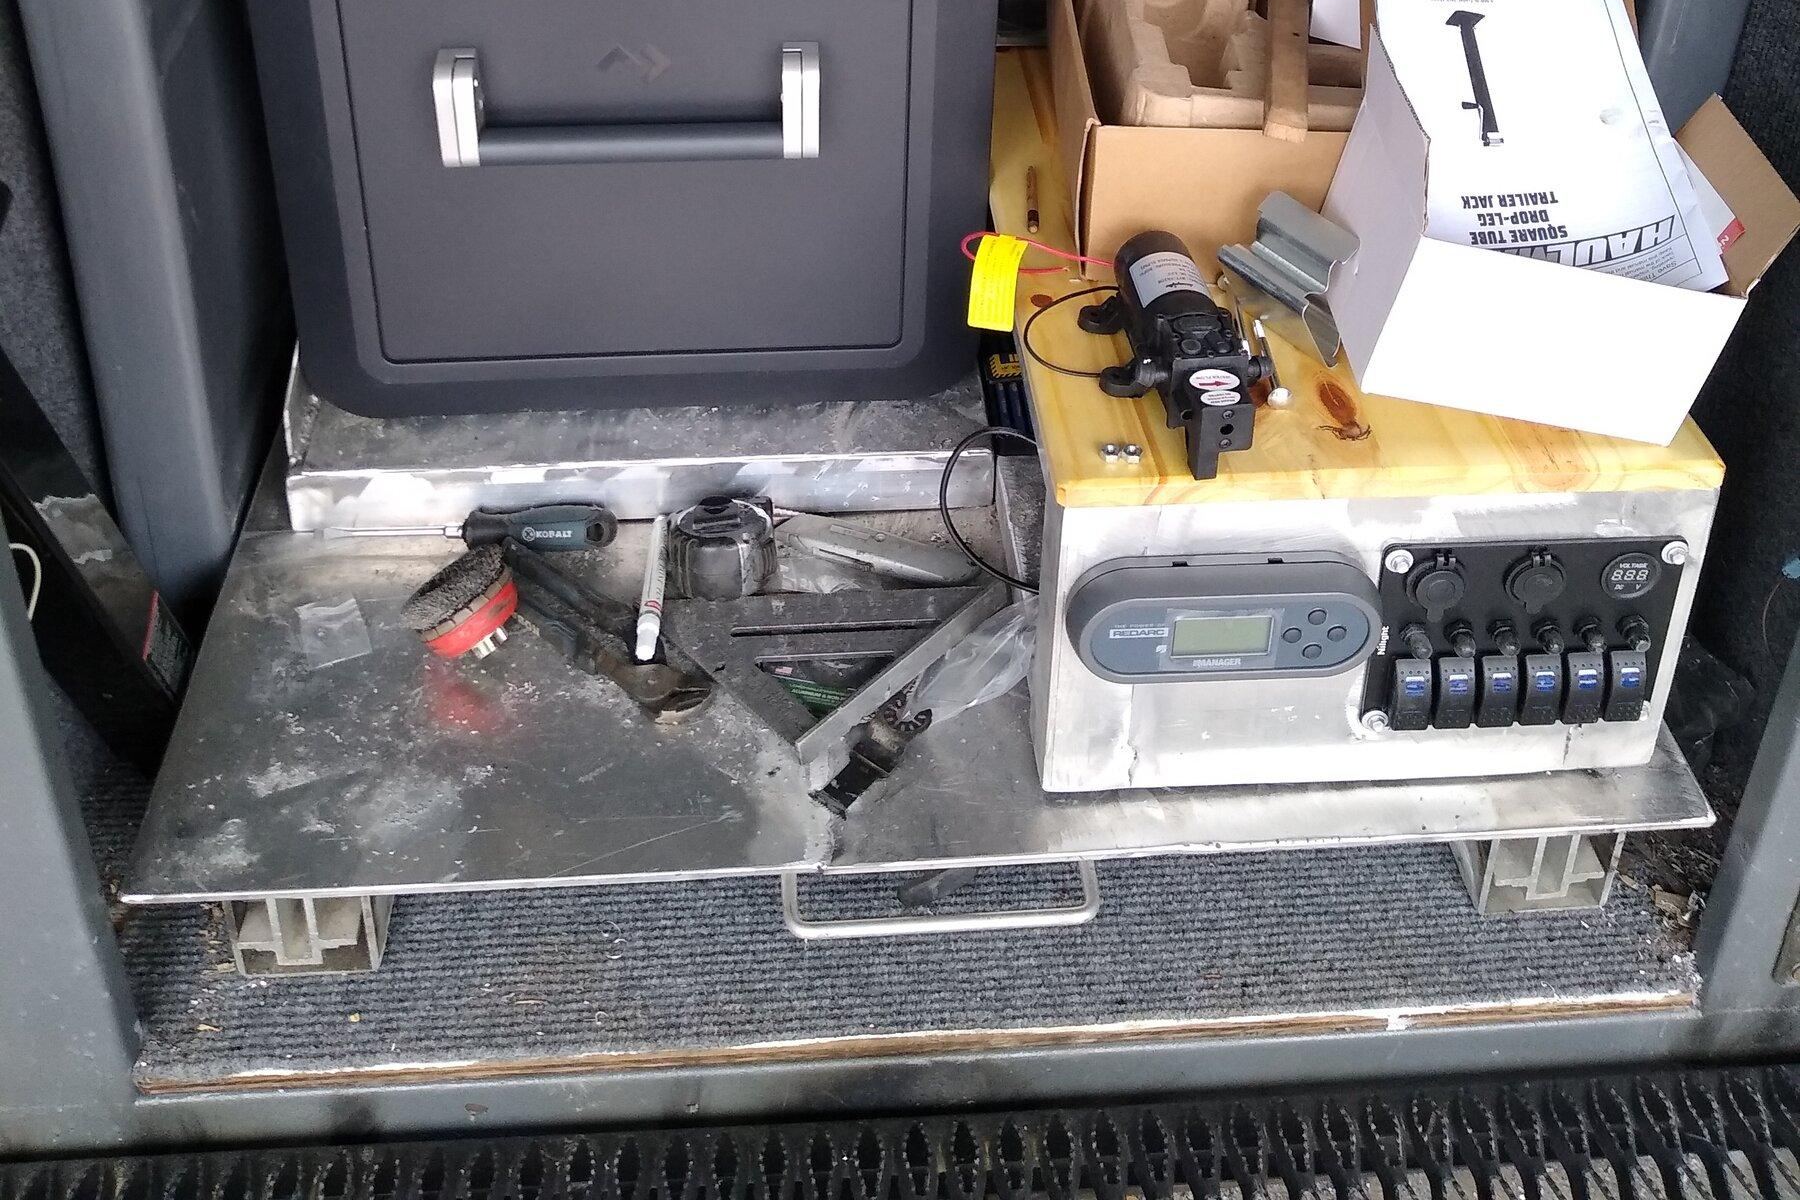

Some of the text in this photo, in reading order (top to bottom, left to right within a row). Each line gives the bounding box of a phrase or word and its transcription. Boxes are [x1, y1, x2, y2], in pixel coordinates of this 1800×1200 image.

[1460, 190, 1559, 210] TRAILER JACK
[1477, 209, 1549, 226] DROP-LEG
[1468, 224, 1569, 246] SQUARE TUBE
[1657, 260, 1677, 274] Save
[536, 530, 572, 538] KOBALT
[1112, 629, 1166, 638] REDARC
[1376, 625, 1389, 656] Nilight
